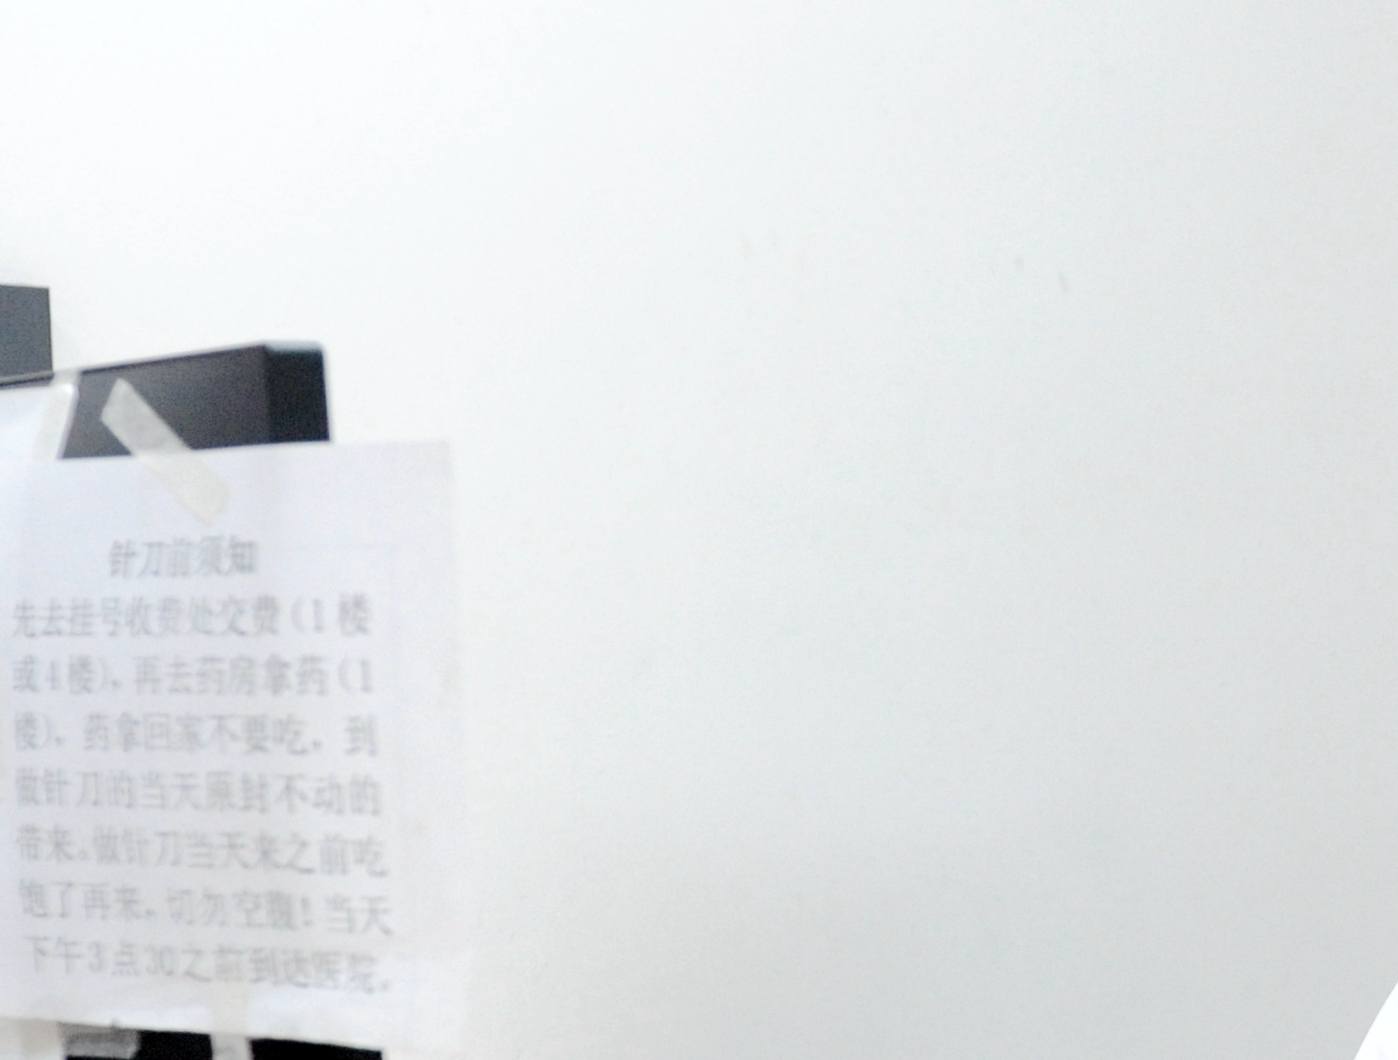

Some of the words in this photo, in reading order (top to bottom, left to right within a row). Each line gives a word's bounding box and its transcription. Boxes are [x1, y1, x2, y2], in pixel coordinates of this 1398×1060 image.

[108, 535, 258, 579] 针刀前须知
[15, 766, 382, 817] 做针刀的当天原封不动的
